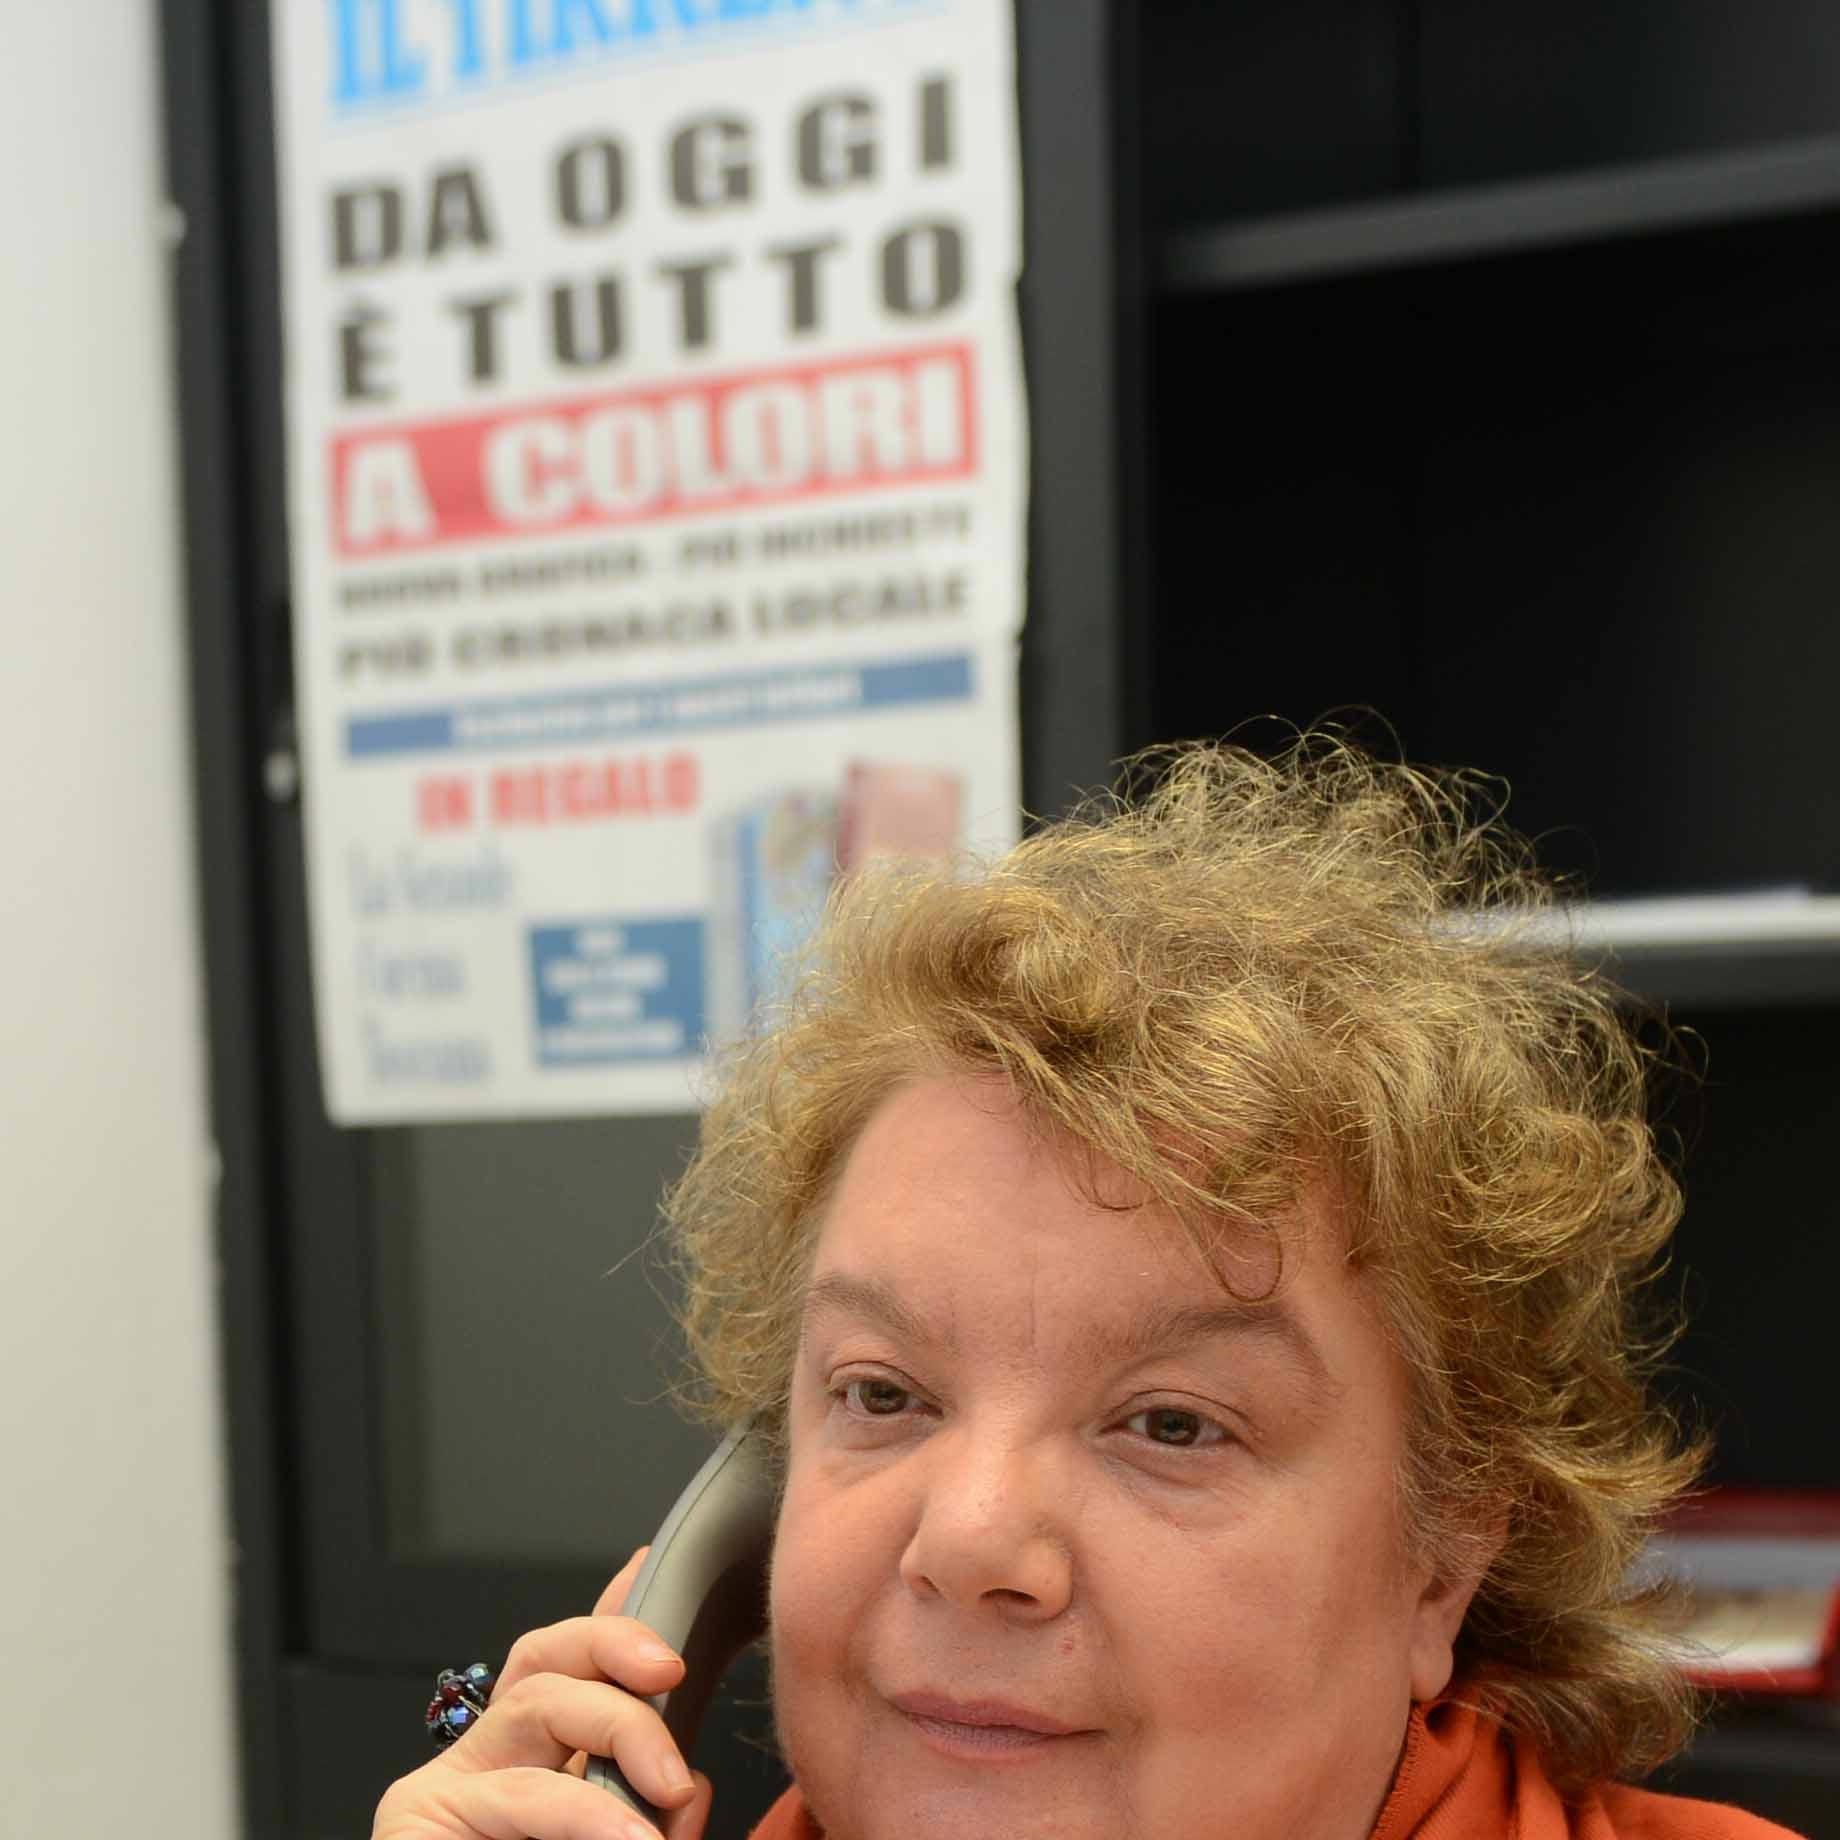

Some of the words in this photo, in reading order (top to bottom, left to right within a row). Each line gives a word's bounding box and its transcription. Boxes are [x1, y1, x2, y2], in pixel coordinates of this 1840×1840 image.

[330, 160, 494, 273] DA
[553, 72, 953, 234] OGGI
[338, 302, 398, 401] È
[450, 218, 971, 387] TUTTO
[344, 434, 437, 545] A
[483, 358, 960, 532] COLORI
[451, 597, 737, 667] CRONACA
[753, 569, 971, 637] LOCALE
[416, 774, 473, 833] IN
[488, 753, 702, 826] REGALO
